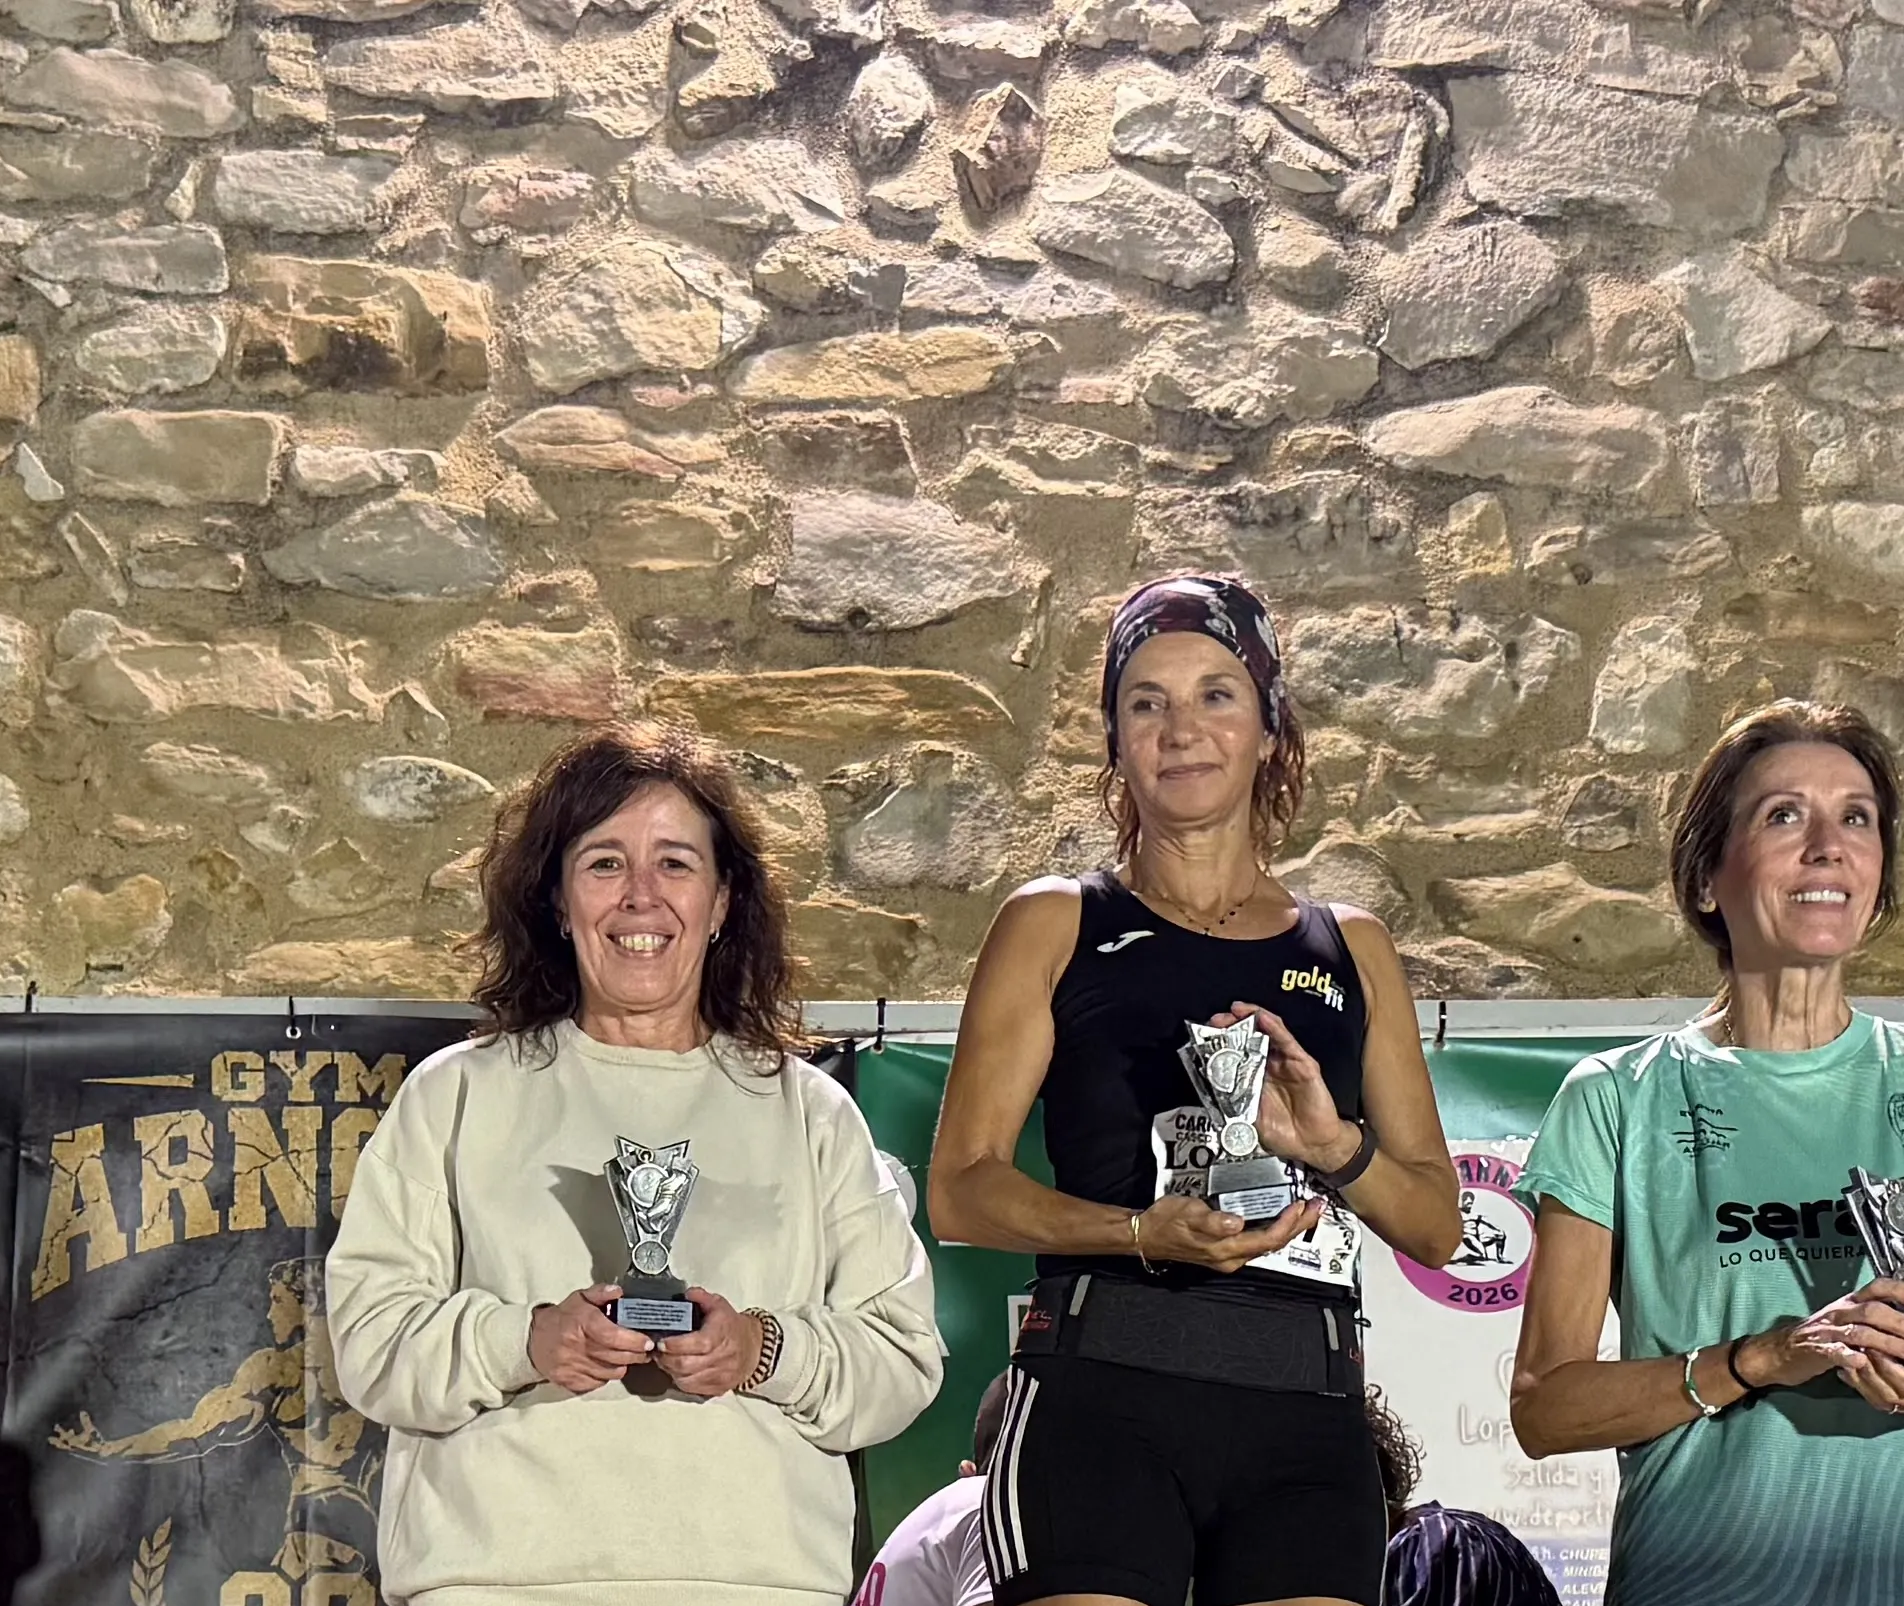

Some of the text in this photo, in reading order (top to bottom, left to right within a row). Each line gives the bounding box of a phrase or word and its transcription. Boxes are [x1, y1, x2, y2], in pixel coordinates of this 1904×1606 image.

[1281, 966, 1332, 994] gold
[211, 1050, 407, 1103] GYM
[1719, 1251, 1742, 1268] LO
[1749, 1248, 1788, 1263] QUE
[1448, 1283, 1519, 1306] 2026
